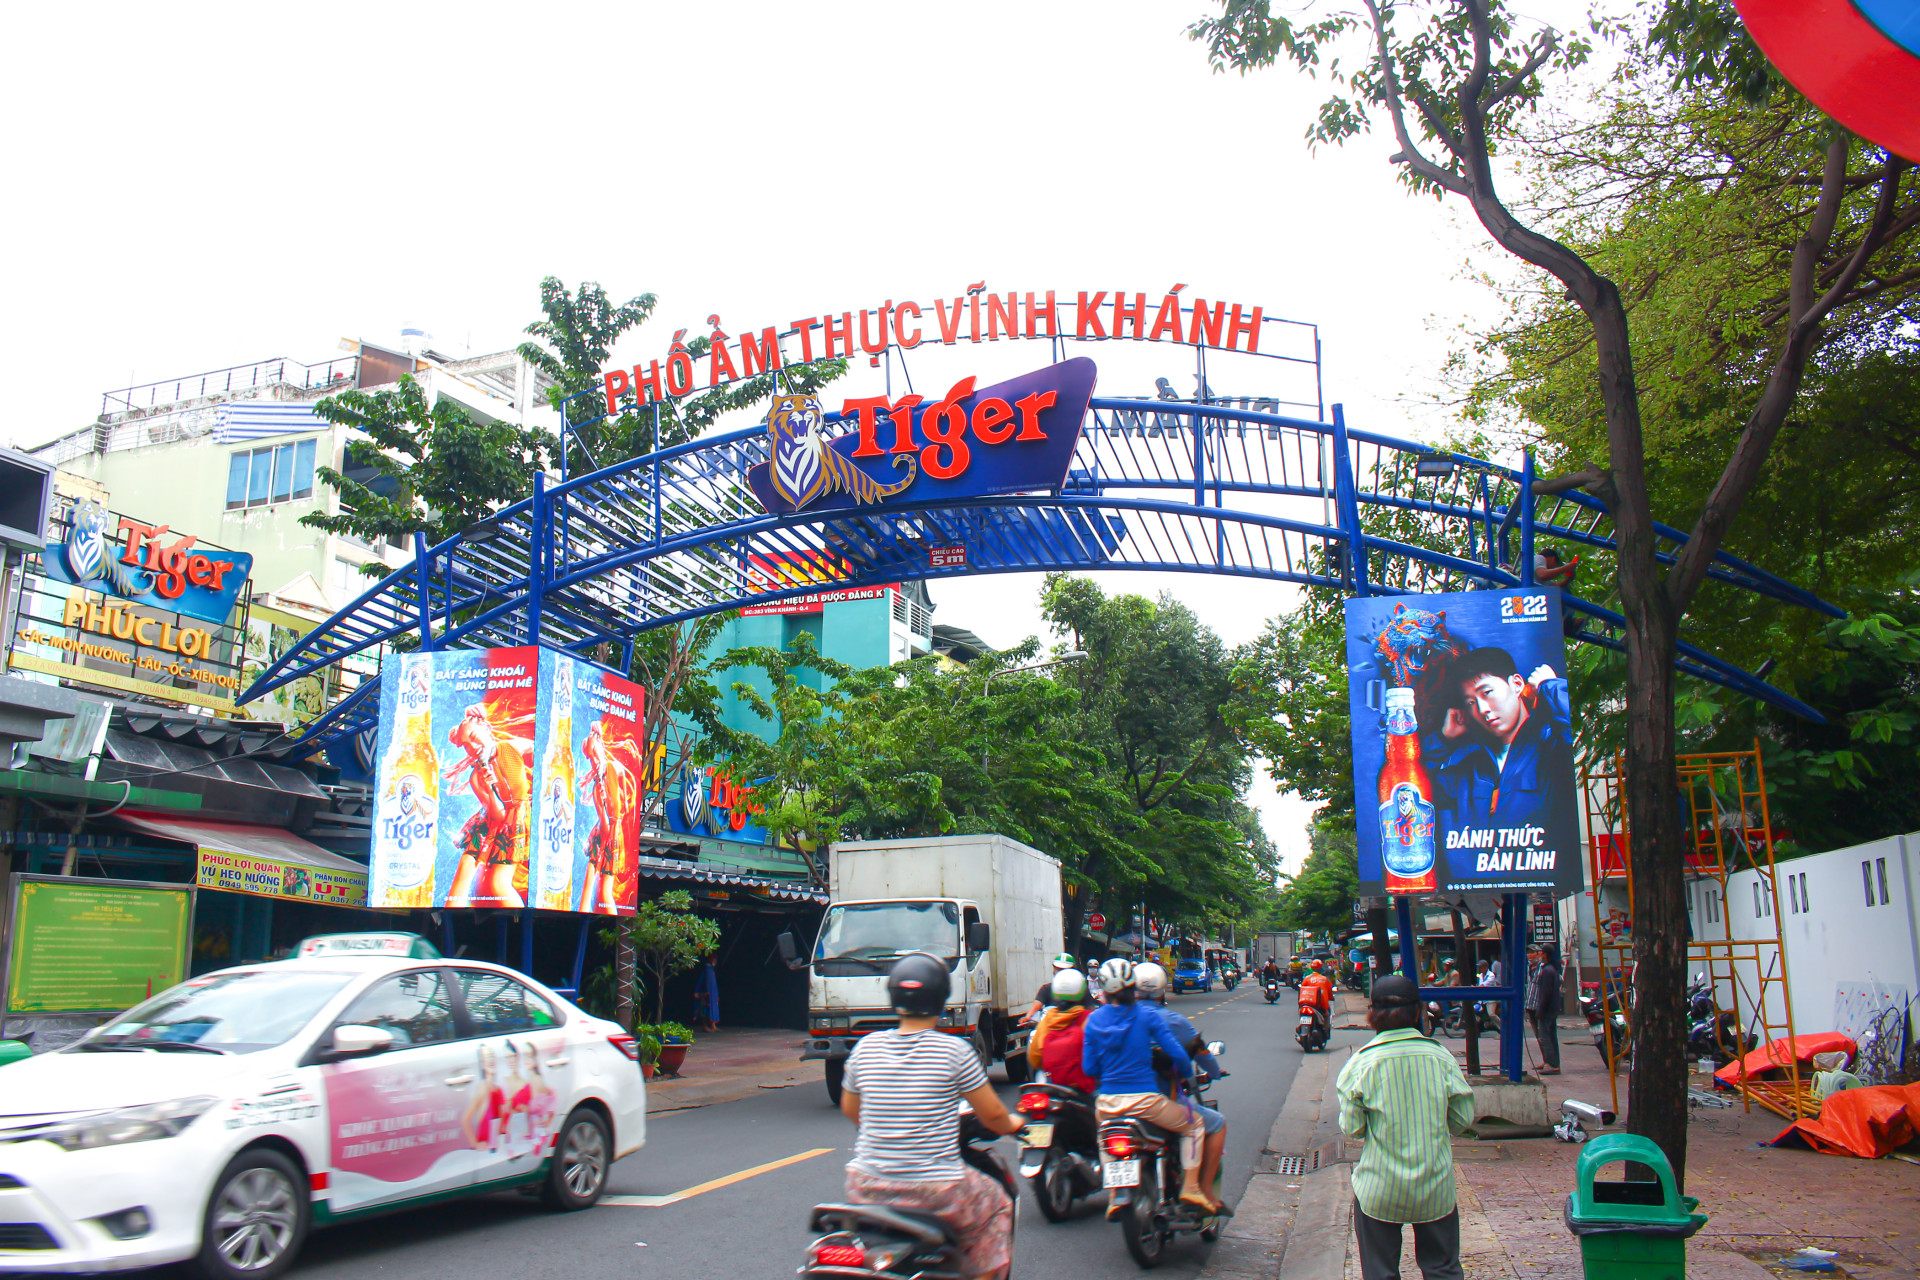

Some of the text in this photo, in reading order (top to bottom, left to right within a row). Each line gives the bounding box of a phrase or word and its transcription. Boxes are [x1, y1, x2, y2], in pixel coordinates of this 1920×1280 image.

[604, 280, 1263, 416] PHỐ ẨM THỰC VĨNH KHÁNH
[841, 375, 1058, 480] Tiger
[118, 518, 235, 599] Tiger
[806, 593, 819, 604] ĐÃ
[821, 591, 846, 603] ĐƯỢC
[848, 590, 874, 600] ĐĂNG
[876, 589, 884, 598] K
[63, 598, 212, 664] PHÚC LỢI
[216, 675, 240, 690] QUE
[435, 669, 457, 683] BẬT
[489, 663, 526, 678] KHOÁI
[487, 679, 514, 690] ĐAM
[515, 676, 534, 688] MÊ
[401, 688, 429, 709] Tiger
[554, 689, 571, 710] Tiger
[611, 690, 633, 708] KHOÁI
[610, 704, 626, 719] ĐAM
[625, 709, 637, 723] MÊ
[382, 814, 434, 850] Tiger
[542, 816, 572, 854] Tiger
[1382, 816, 1435, 847] Tiger
[1446, 823, 1546, 849] ĐÁNH THỨC
[202, 853, 281, 875] PHÚC LỢI QUÁN
[1476, 847, 1557, 872] BẢN LĨNH
[201, 864, 280, 887] VÚ HEO NƯỚNG
[201, 877, 279, 895] ĐT: 0949 595 778
[313, 893, 328, 902] ĐT:
[315, 880, 350, 897] ÚT
